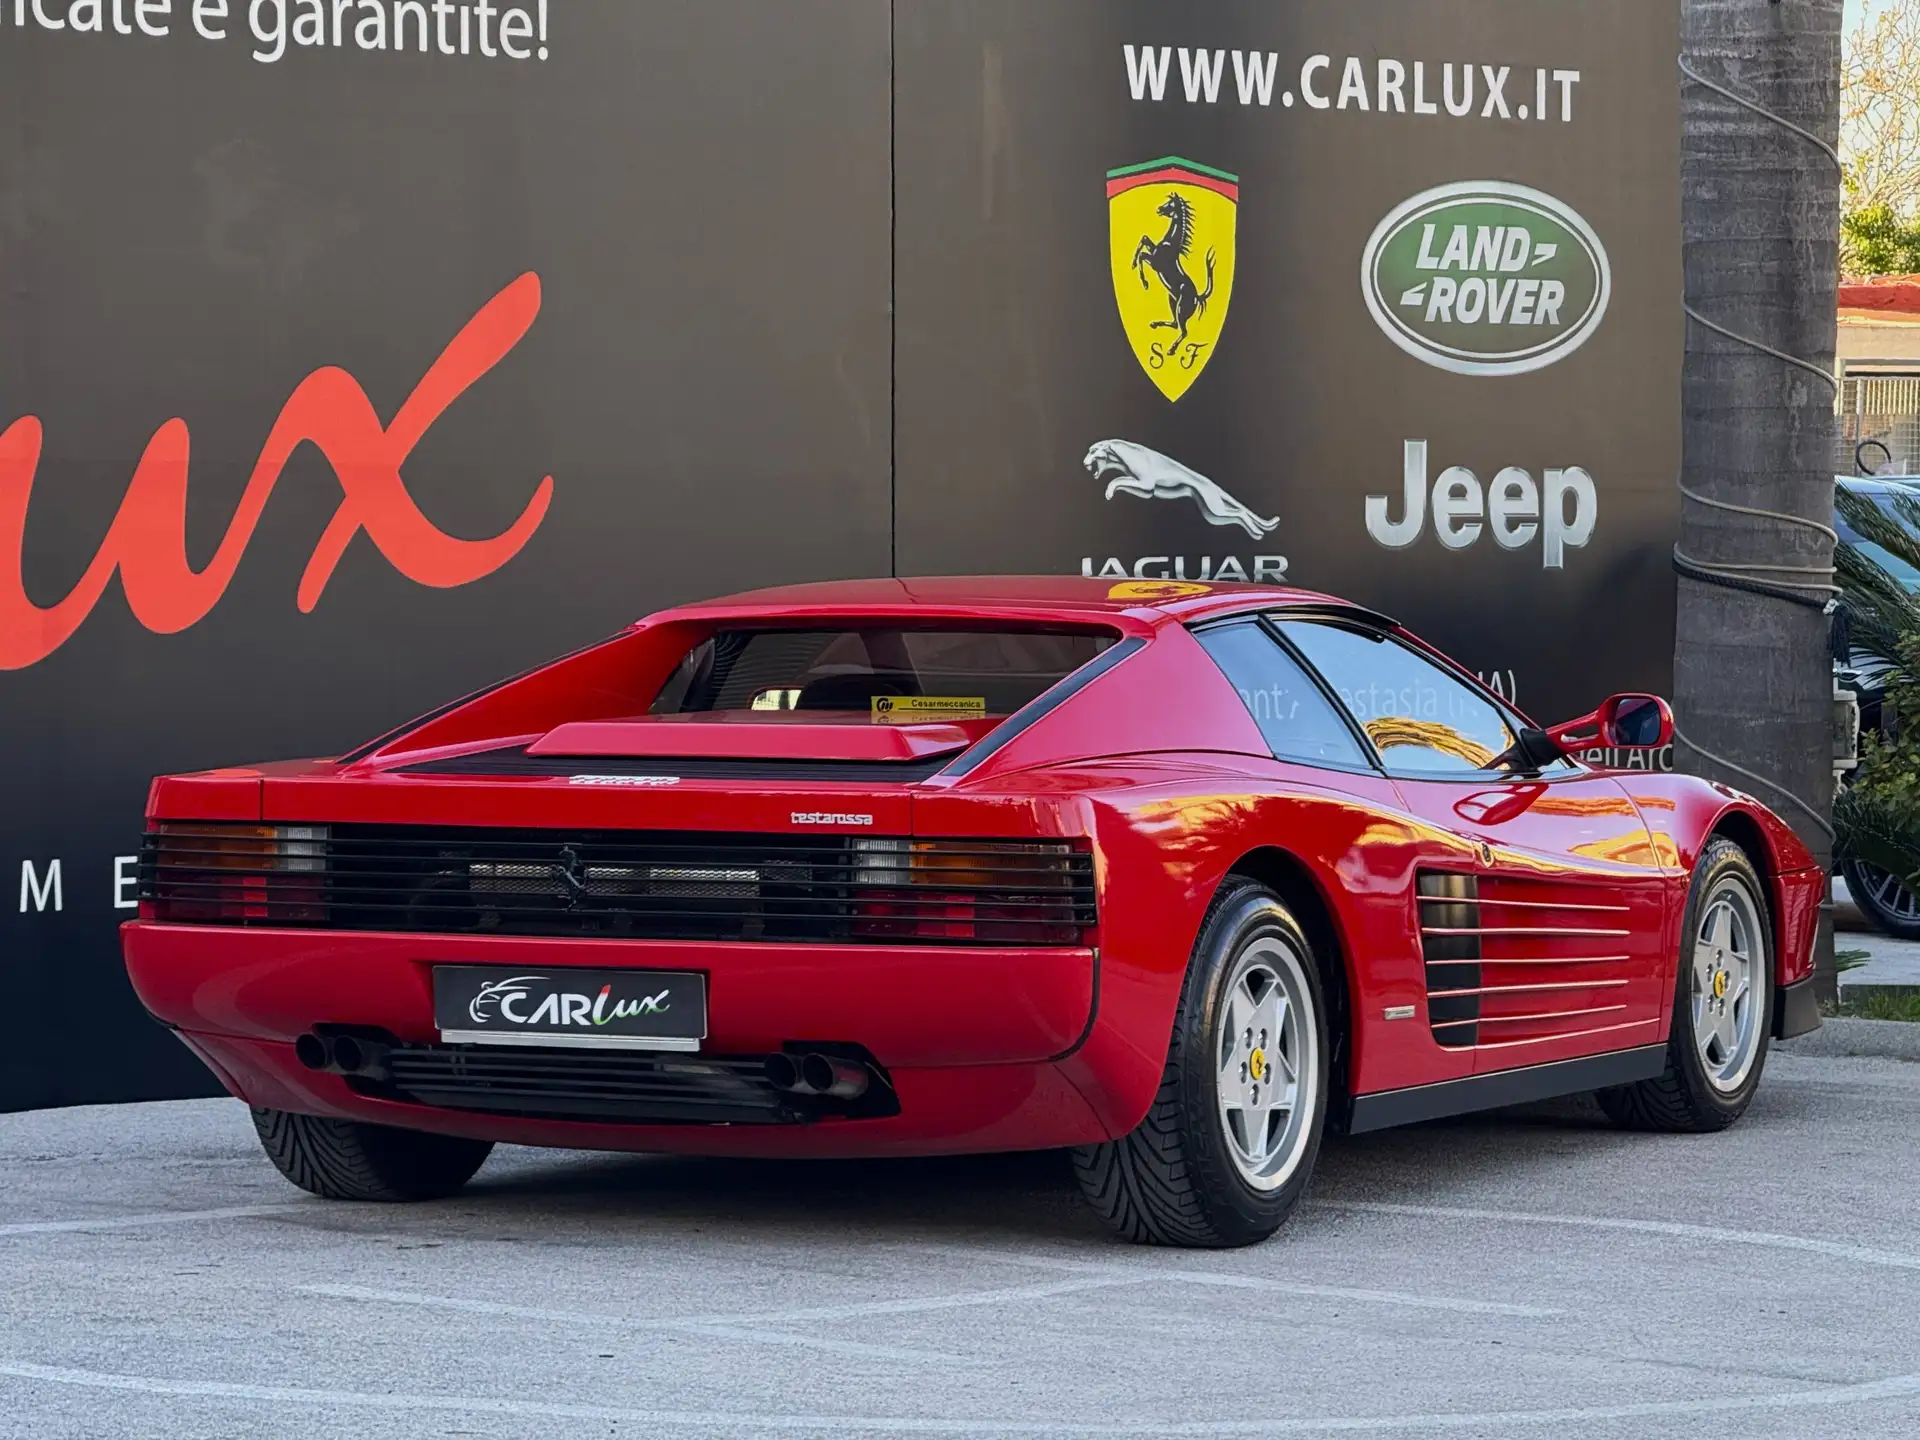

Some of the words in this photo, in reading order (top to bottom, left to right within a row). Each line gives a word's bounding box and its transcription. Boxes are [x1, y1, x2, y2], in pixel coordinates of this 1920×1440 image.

[192, 0, 229, 40] e
[248, 0, 547, 62] garantite!
[1123, 44, 1580, 122] WWW.CARLUX.IT
[1415, 223, 1531, 272] LAND
[1424, 276, 1565, 325] ROVER
[1365, 438, 1598, 568] Jeep
[911, 699, 981, 708] Cesarmeccanica
[791, 812, 873, 825] testarossa
